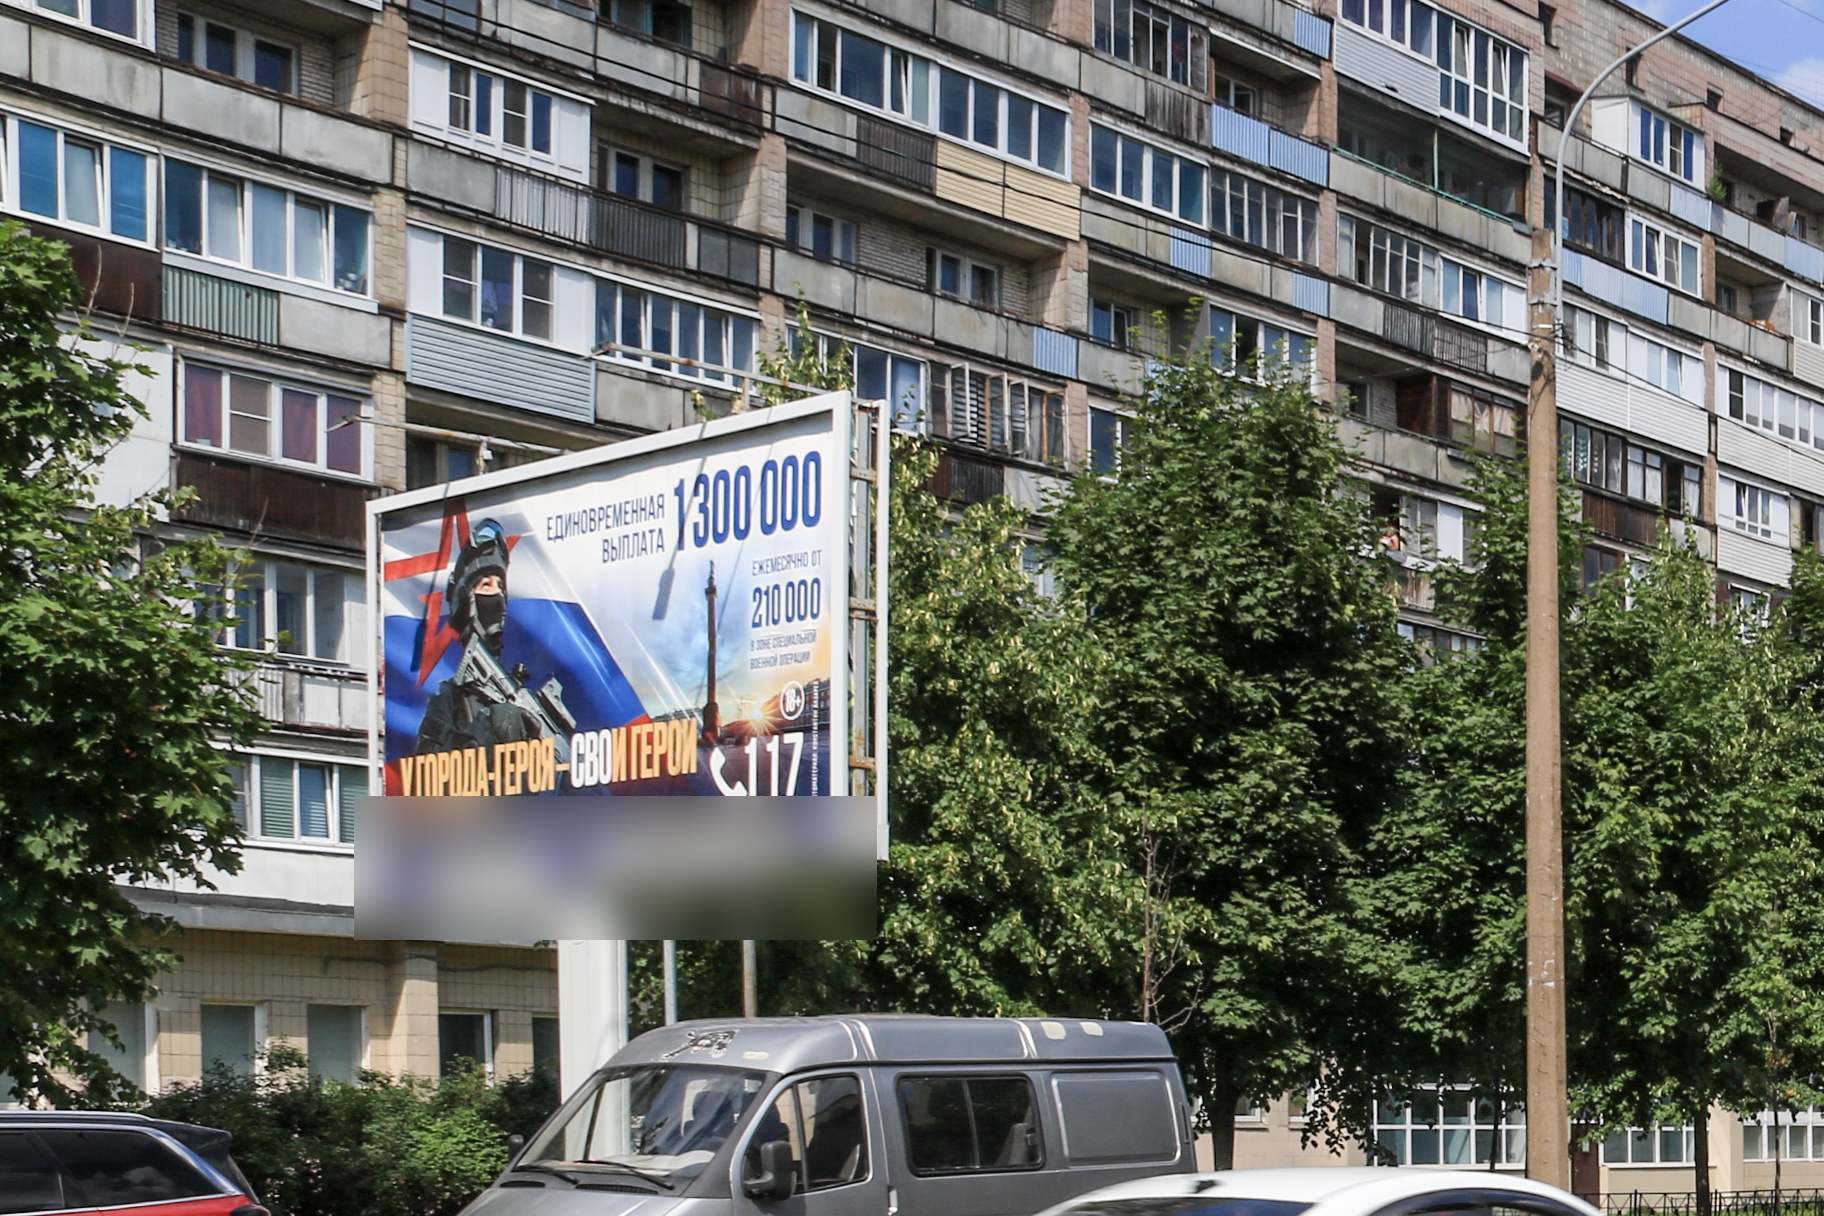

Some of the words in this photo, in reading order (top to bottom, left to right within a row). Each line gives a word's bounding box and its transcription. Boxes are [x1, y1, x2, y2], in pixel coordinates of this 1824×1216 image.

[547, 494, 665, 543] ЕДИНОВРЕМЕННАЯ
[602, 528, 665, 564] ВЫПЛАТА
[752, 551, 809, 576] ЕЖЕМЕСЯЧНО
[811, 549, 822, 567] ОТ
[785, 687, 801, 713] 18+
[416, 737, 555, 797] ГОРОДА-ГЕРОЯ
[570, 726, 627, 789] СВОИ
[631, 718, 697, 782] ГЕРОИ
[744, 731, 804, 797] 117
